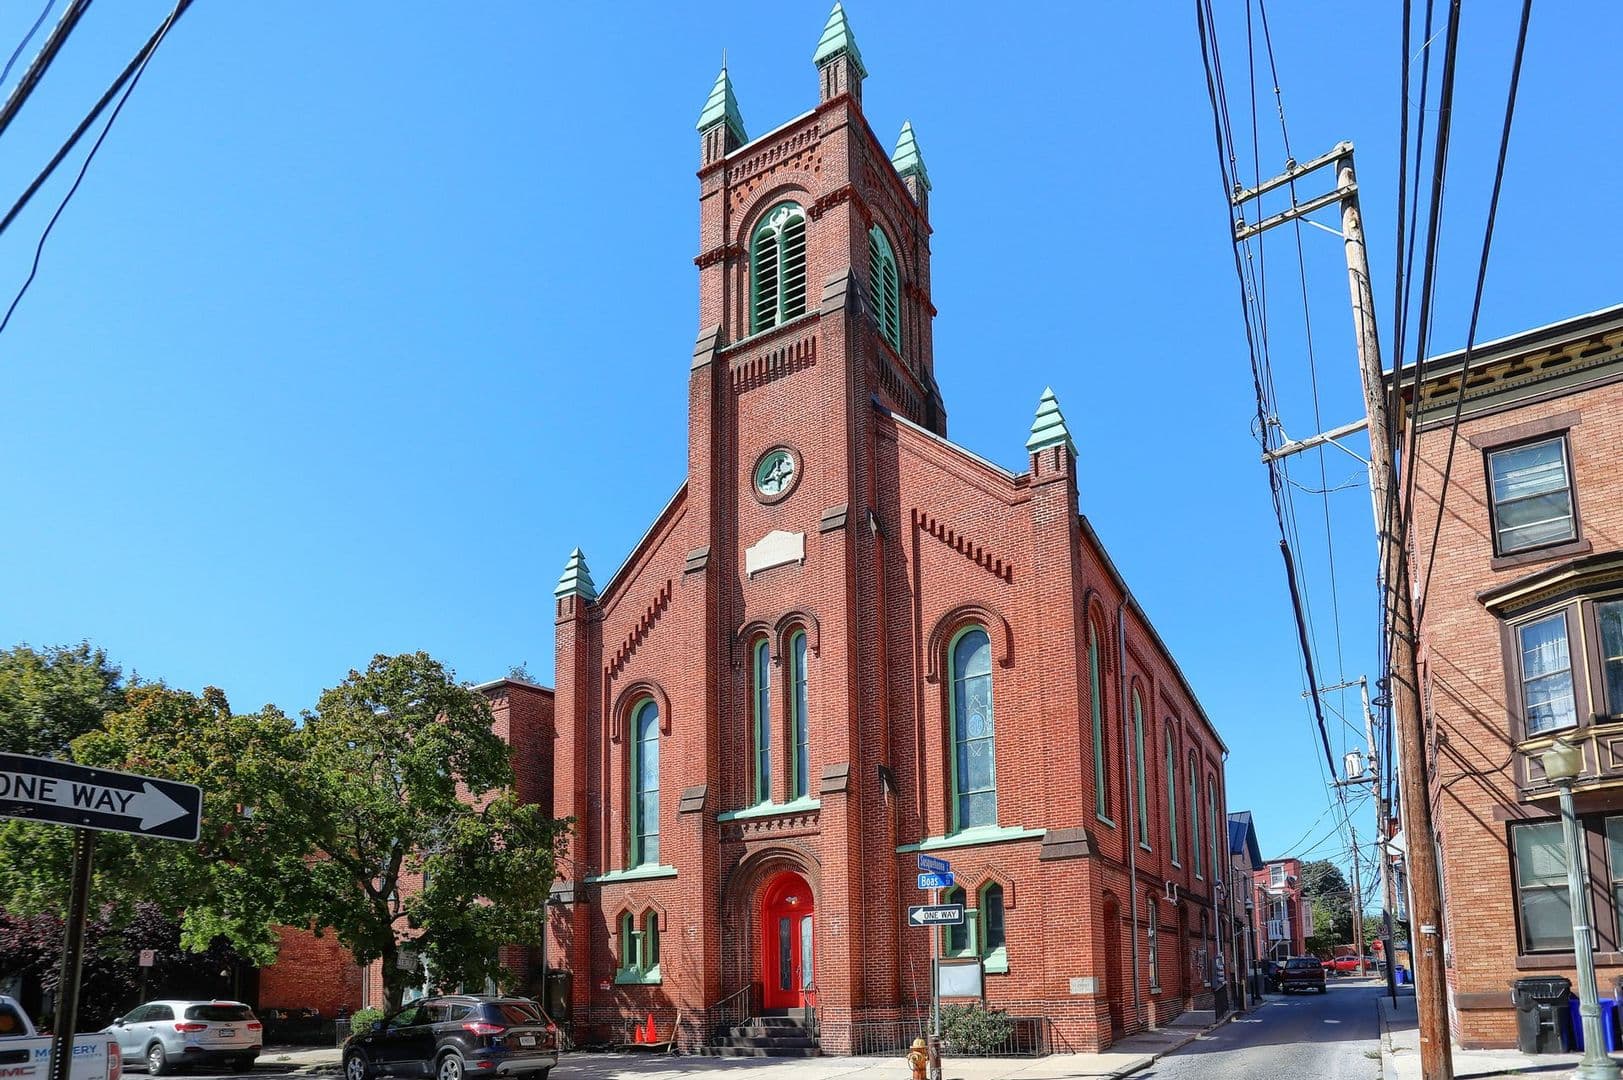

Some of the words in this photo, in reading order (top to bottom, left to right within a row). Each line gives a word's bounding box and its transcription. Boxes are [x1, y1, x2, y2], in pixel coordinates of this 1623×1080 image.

[0, 773, 57, 802] ONE
[72, 783, 135, 813] WAY
[921, 876, 938, 887] Boas
[924, 912, 938, 920] ONE
[941, 910, 957, 919] WAY
[35, 1045, 97, 1058] MERY
[0, 1066, 36, 1076] MC
